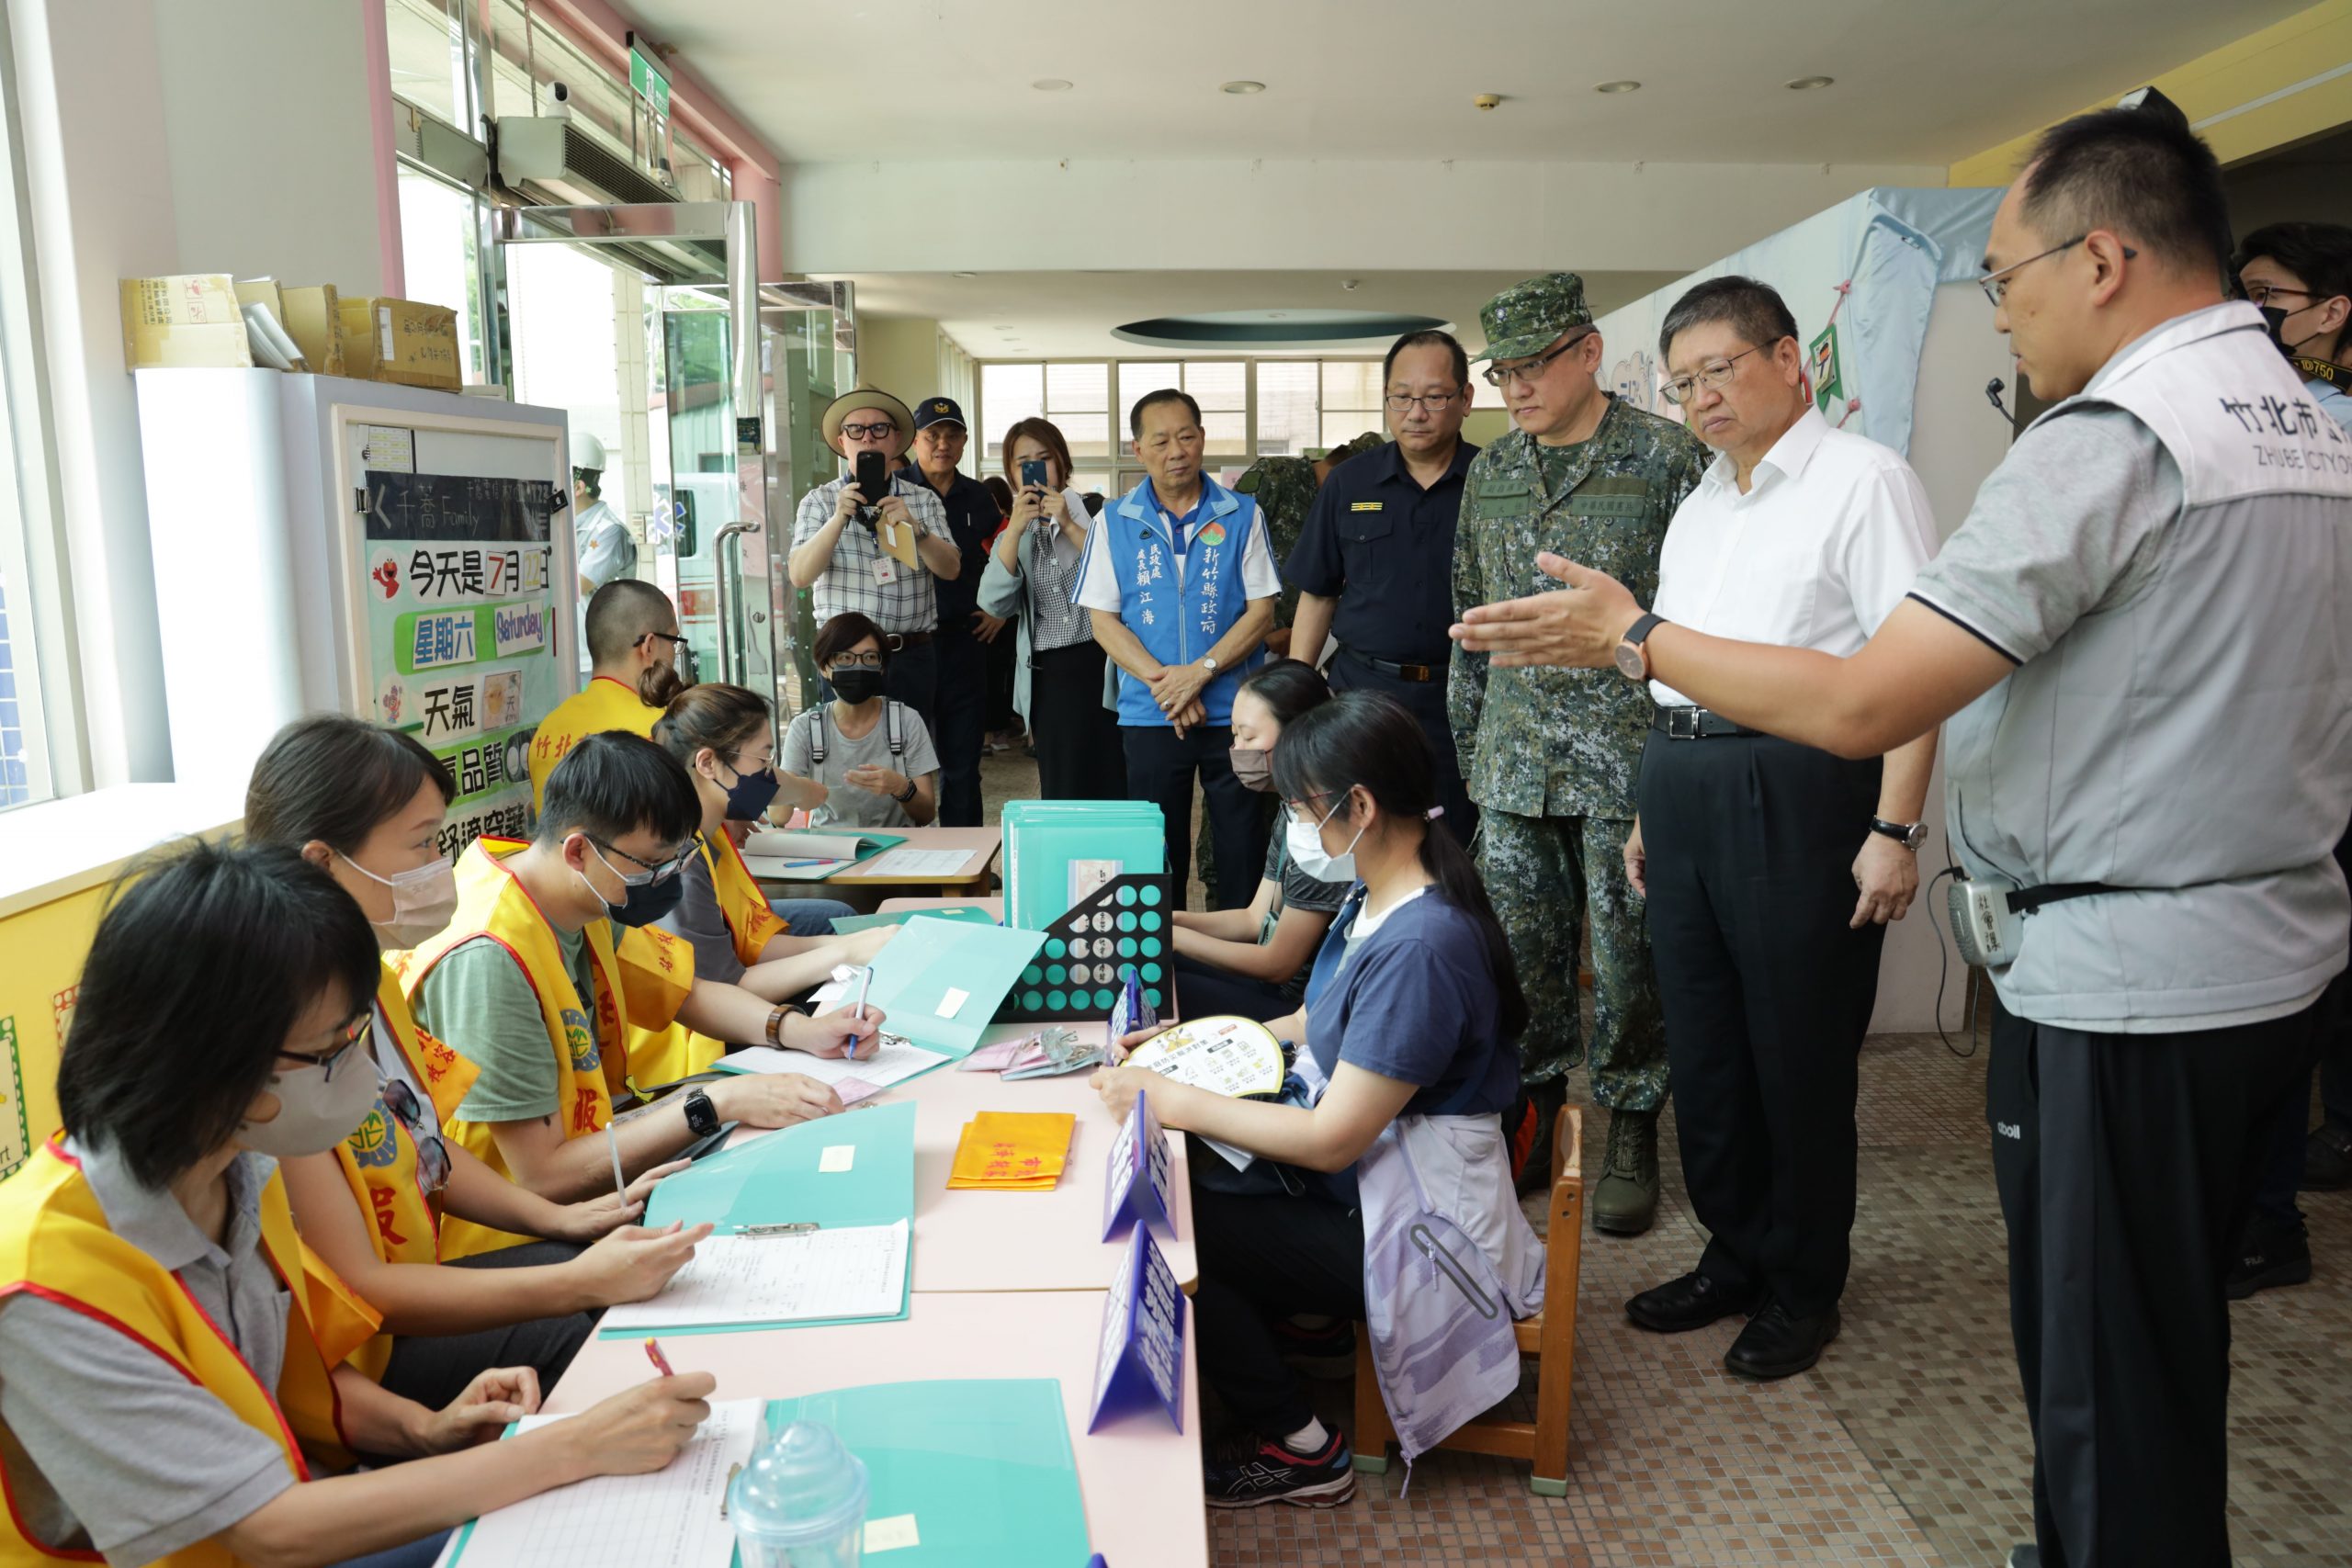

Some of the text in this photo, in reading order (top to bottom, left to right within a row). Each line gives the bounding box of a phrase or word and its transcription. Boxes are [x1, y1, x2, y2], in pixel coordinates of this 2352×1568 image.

[442, 495, 480, 537] Family
[1149, 544, 1163, 580] 民政處
[1201, 547, 1220, 635] 新竹縣政府
[415, 615, 473, 664] 星期六
[496, 604, 543, 644] Saturday
[424, 685, 475, 737] 天氣
[1978, 895, 2002, 953] 社會課
[573, 1088, 602, 1133] 服
